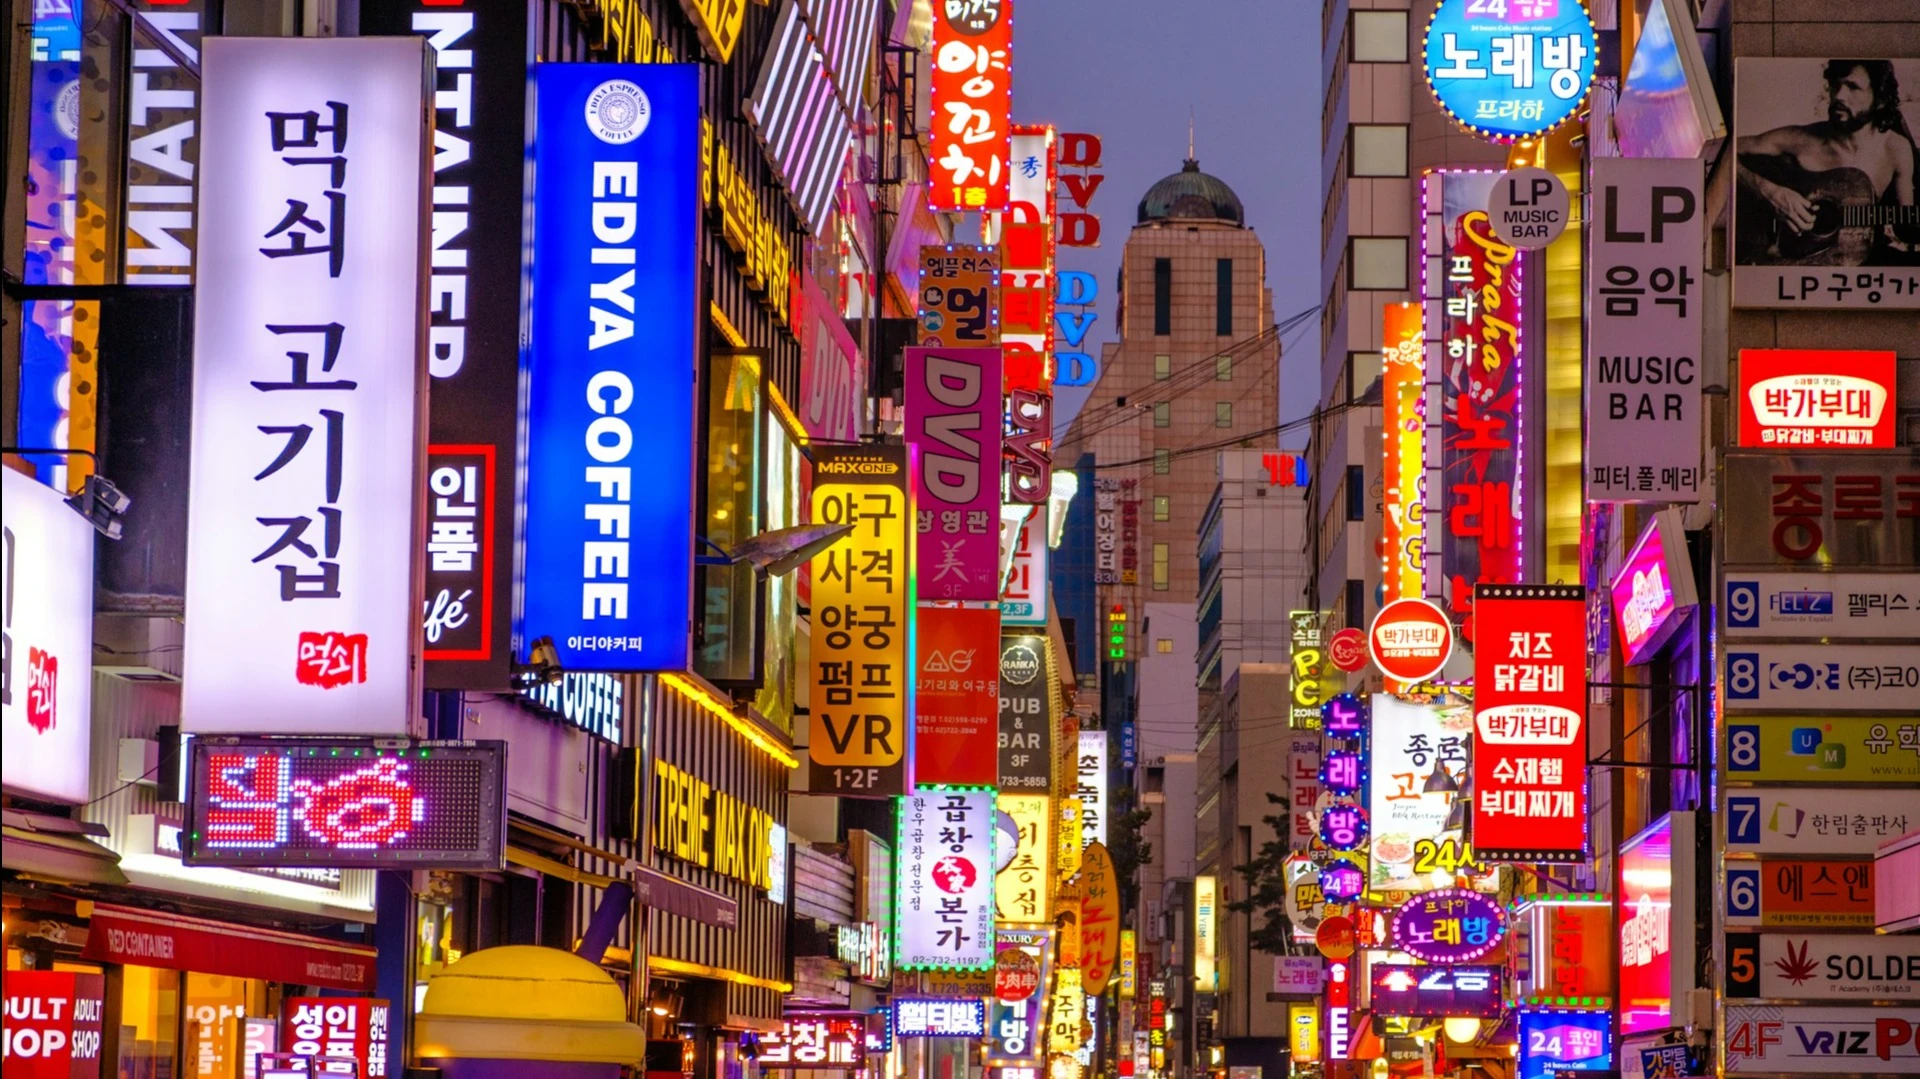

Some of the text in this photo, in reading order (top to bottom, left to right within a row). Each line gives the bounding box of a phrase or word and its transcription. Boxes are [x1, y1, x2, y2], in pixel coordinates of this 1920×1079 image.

[1435, 33, 1588, 99] 노래방
[937, 40, 1006, 186] 양꼬치
[1475, 99, 1545, 121] 프라하
[1058, 133, 1104, 247] DVD
[1509, 178, 1553, 206] LP
[1503, 209, 1559, 223] MUSIC
[1605, 185, 1696, 243] LP
[1512, 225, 1549, 238] BAR
[927, 257, 993, 278] 엠플러스
[1599, 266, 1695, 318] 음악
[1778, 276, 1819, 300] LP
[1447, 256, 1477, 366] 프라하
[1054, 271, 1098, 386] DVD
[250, 101, 357, 602] 먹쇠 고기집
[1599, 356, 1695, 385] MUSIC
[582, 161, 638, 620] EDIYA COFFEE
[1765, 389, 1871, 418] 박가부대
[1609, 393, 1683, 421] BAR
[923, 355, 983, 504] DVD
[1005, 389, 1053, 502] DVD
[821, 493, 897, 537] 야구
[820, 549, 893, 594] 사격
[932, 539, 969, 583] 美
[943, 584, 962, 597] 3F
[1731, 588, 1909, 622] 9 펠리스
[820, 605, 896, 650] 양궁
[1383, 628, 1438, 645] 박가부대
[567, 636, 642, 651] 이디야커피
[1508, 632, 1554, 659] 치즈
[1003, 660, 1035, 669] RANKA
[1294, 650, 1320, 706] PC
[1494, 665, 1564, 692] 닭갈비
[1731, 658, 1755, 694] 8
[819, 660, 896, 706] 펌프
[563, 672, 622, 745] COFFEE
[999, 698, 1041, 714] PUB
[1293, 708, 1320, 718] ZONE
[821, 714, 894, 755] VR
[1014, 717, 1024, 730] &
[1488, 714, 1569, 740] 박가부대
[998, 733, 1041, 749] BAR
[1403, 734, 1466, 767] 종로
[1732, 731, 1838, 766] 8 U M
[1011, 754, 1029, 767] 3F
[1328, 702, 1360, 845] 노래방
[1493, 758, 1563, 786] 수제햄
[1002, 777, 1047, 787] 733-5858
[1480, 789, 1574, 819] 부대찌개
[653, 757, 774, 891] TREME MAX ONE
[937, 795, 973, 853] 곱창
[1733, 804, 1909, 837] 7 한림출판사
[1325, 874, 1342, 893] 24
[1731, 865, 1869, 911] 6 에스앤
[935, 897, 971, 951] 본가
[1409, 917, 1490, 945] 노래방
[126, 931, 174, 959] CONTAINER
[912, 956, 981, 965] 02-732-1197
[1279, 970, 1319, 986] 노래방
[1731, 948, 1755, 983] 5
[1839, 985, 1870, 994] Academy
[74, 998, 101, 1021] ADULT
[290, 1004, 357, 1040] 성인
[1056, 995, 1078, 1044] 주막
[71, 1031, 100, 1058] SHOP
[1530, 1030, 1598, 1057] 24 코인
[1728, 1021, 1784, 1059] 4F
[1875, 1018, 1920, 1061] P
